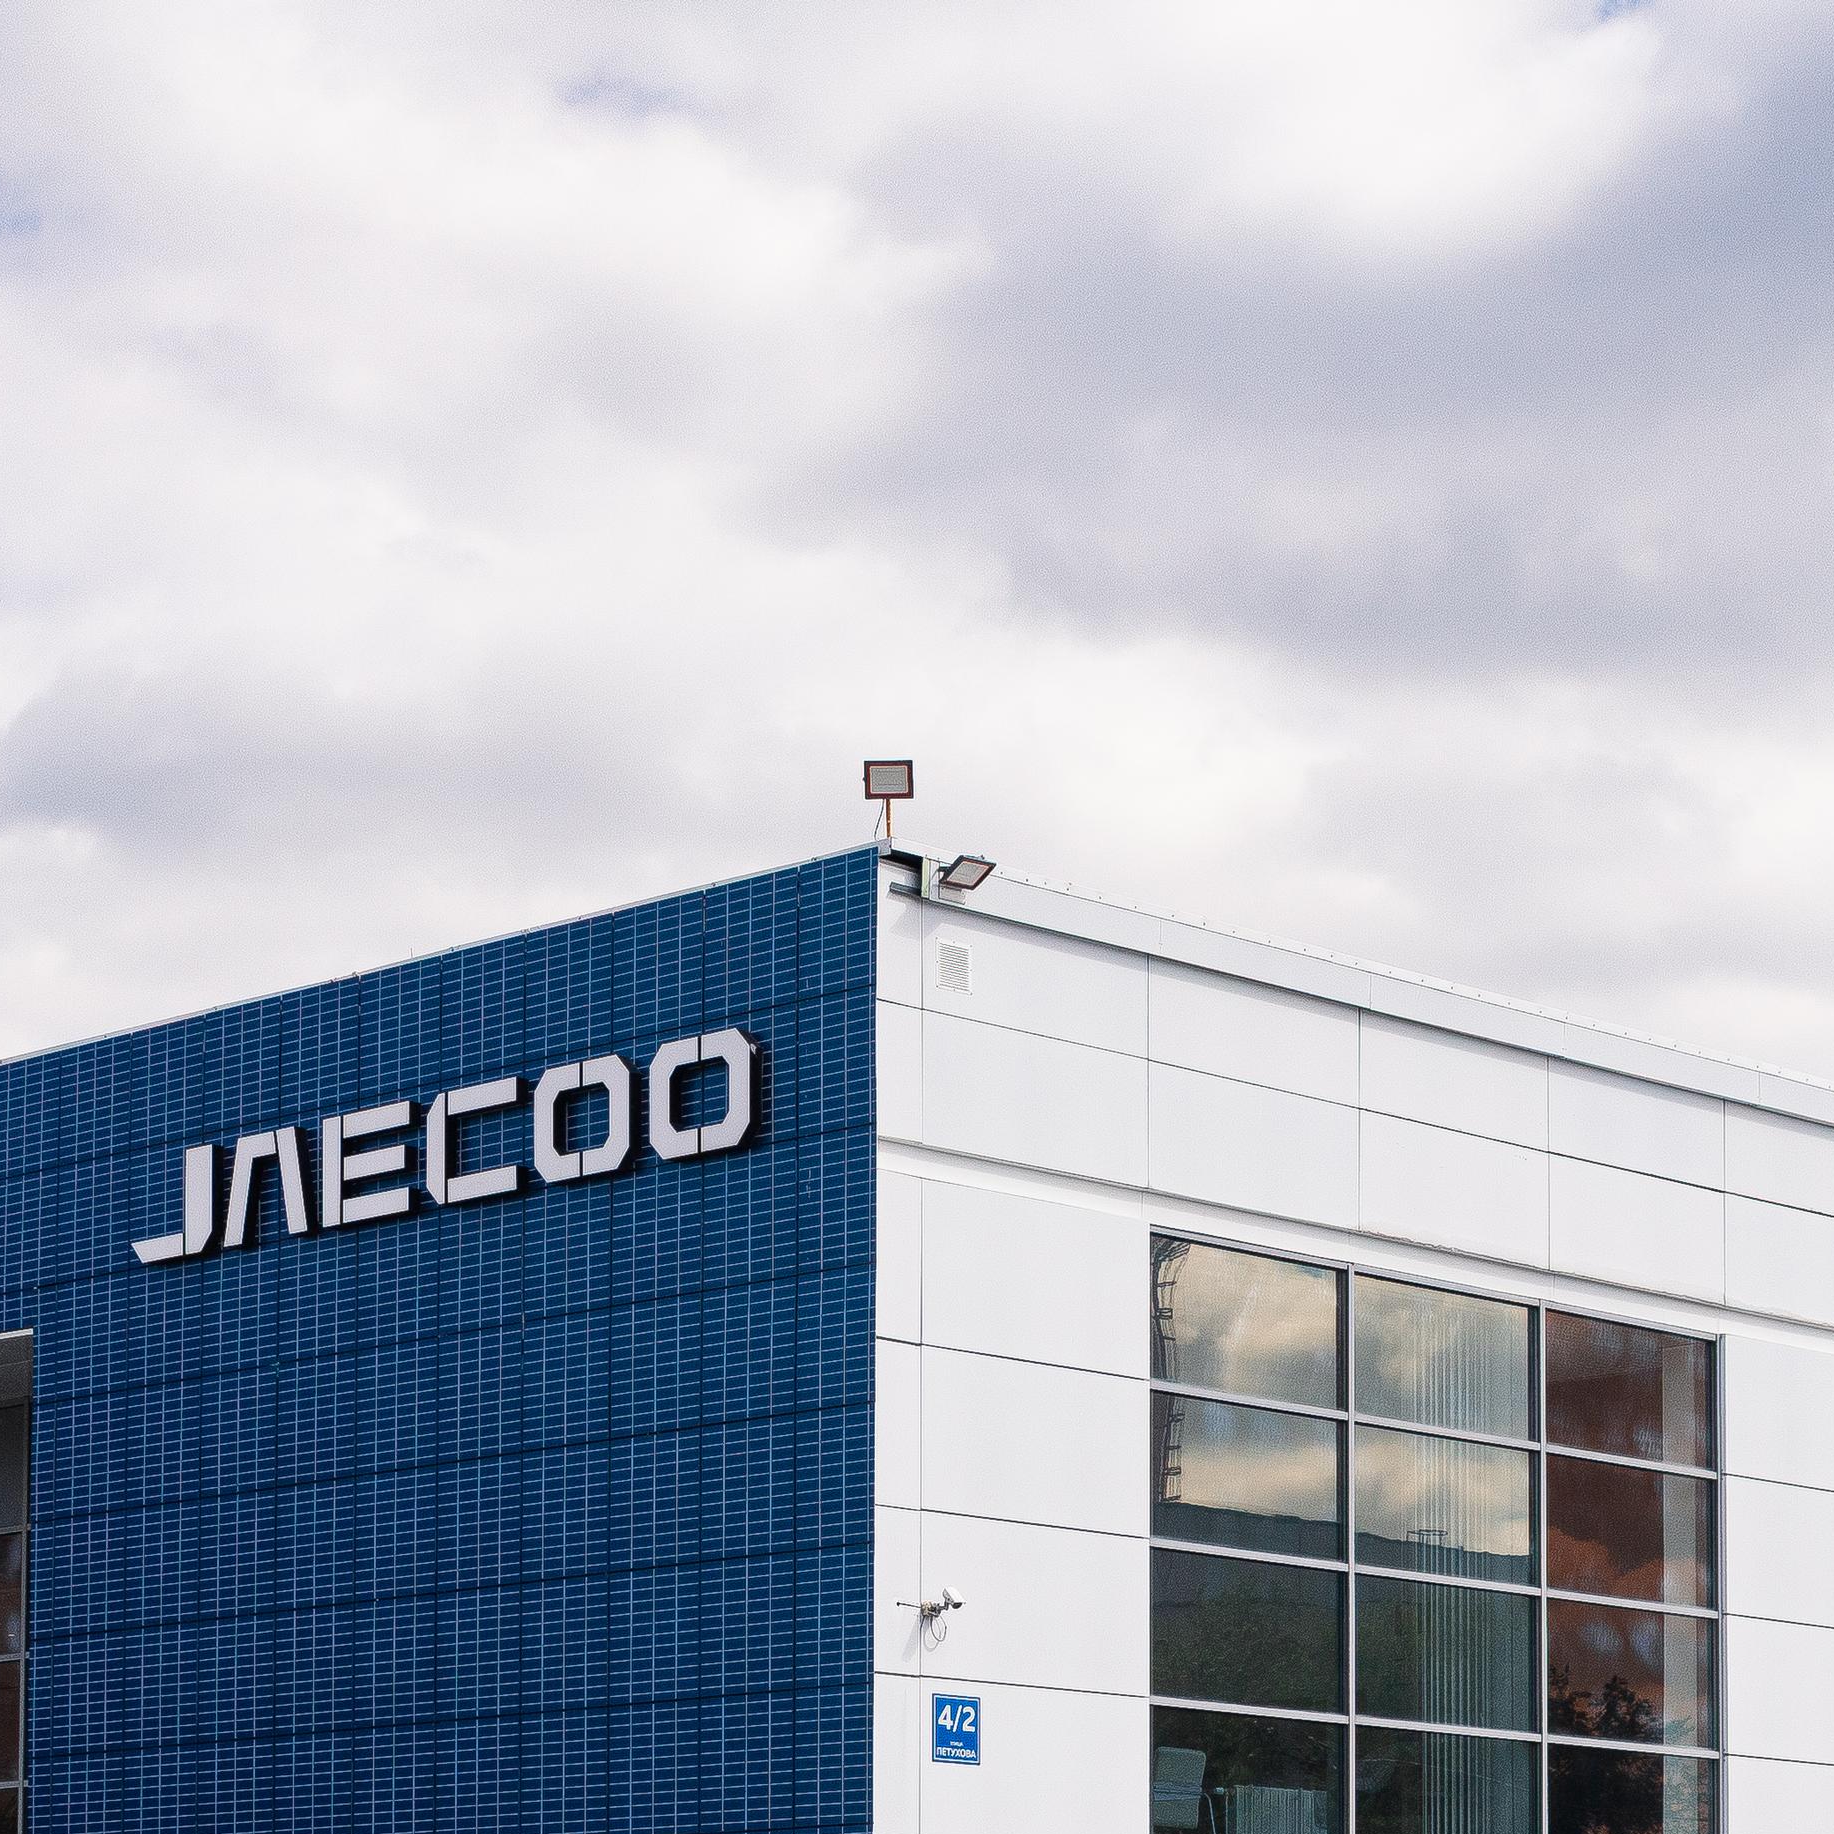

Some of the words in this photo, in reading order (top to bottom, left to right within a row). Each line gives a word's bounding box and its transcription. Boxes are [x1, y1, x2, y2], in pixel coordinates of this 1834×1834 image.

[130, 1027, 757, 1265] JAECOO
[937, 1704, 976, 1733] 4/2
[936, 1747, 976, 1758] ПЕТУХОВА
